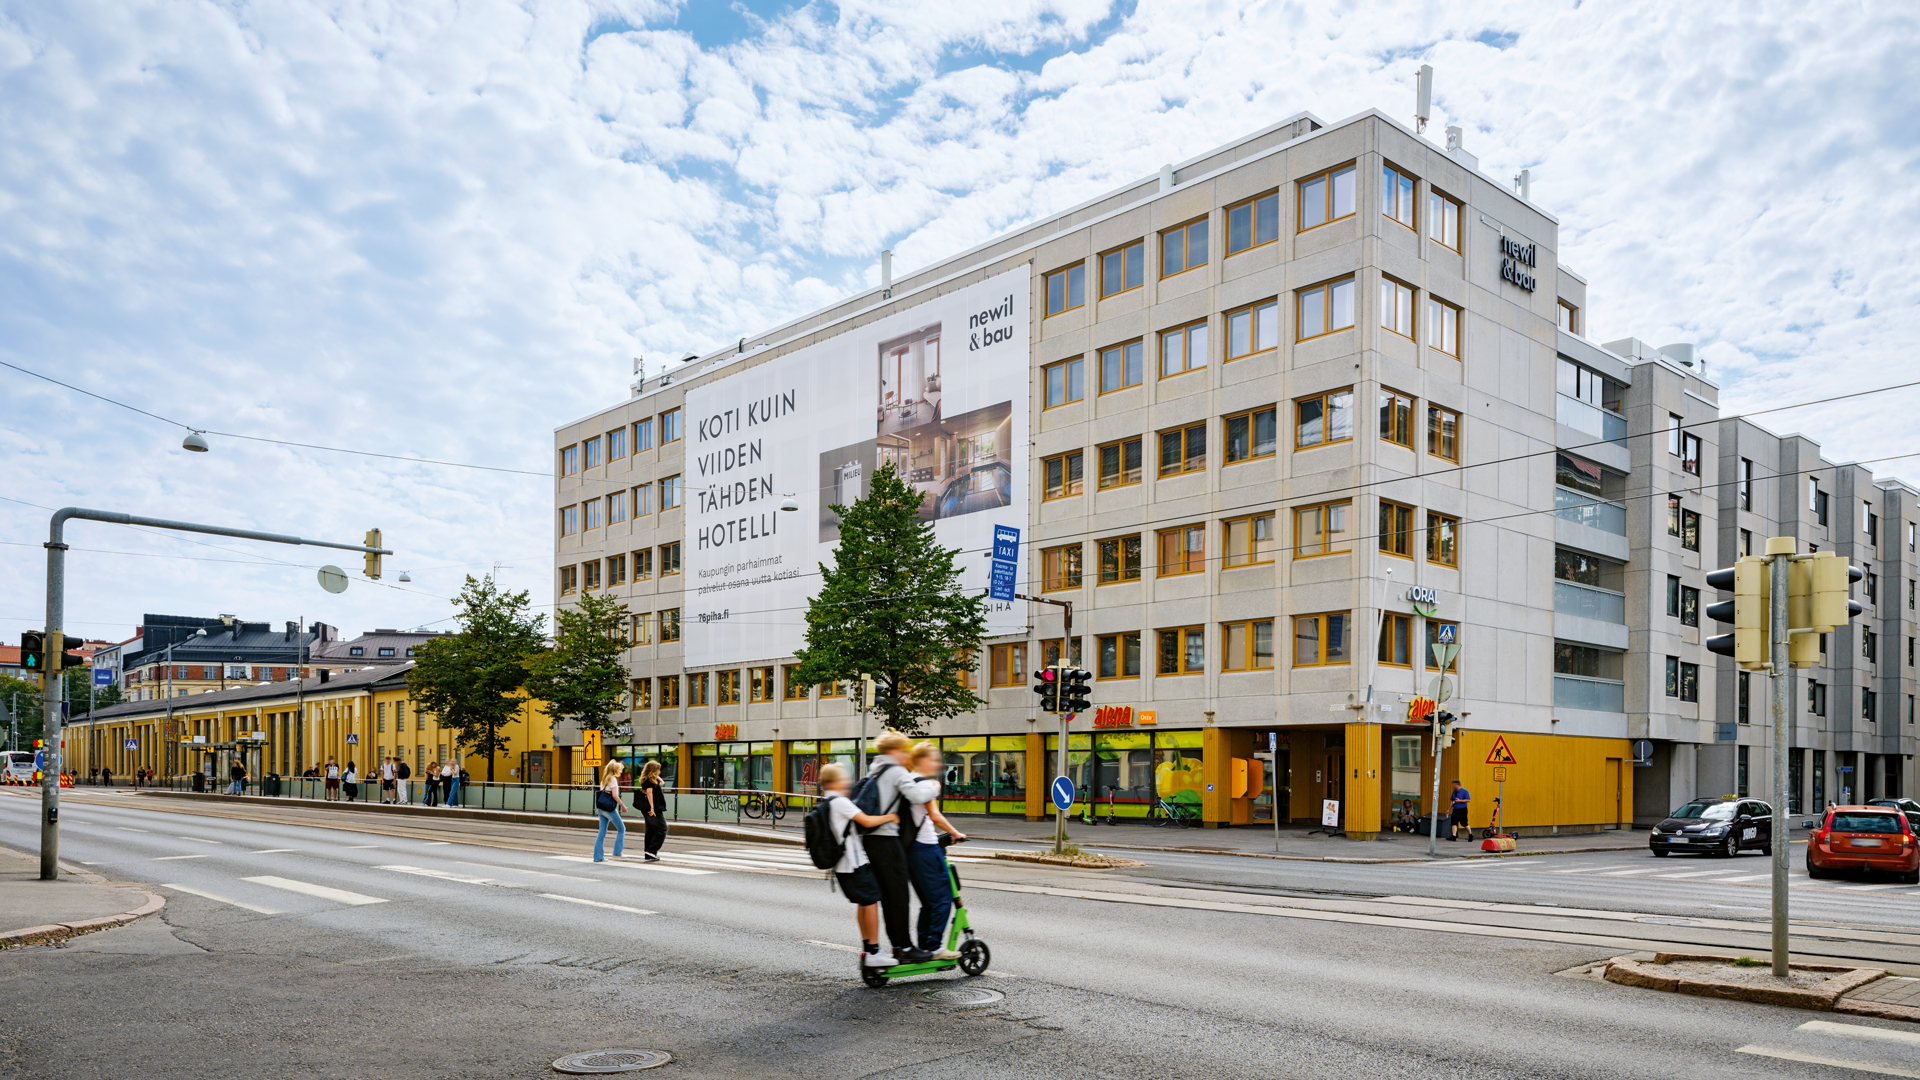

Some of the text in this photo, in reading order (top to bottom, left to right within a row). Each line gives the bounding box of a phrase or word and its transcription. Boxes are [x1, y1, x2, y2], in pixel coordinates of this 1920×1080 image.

[1502, 236, 1536, 268] newil
[1502, 258, 1536, 292] & bau
[970, 294, 1013, 329] newil
[970, 325, 1013, 351] & bau
[700, 389, 794, 442] KOTI KUIN
[698, 438, 761, 477] VIIDEN
[698, 473, 772, 514] TÄHDEN
[699, 511, 776, 550] HOTELLI
[998, 546, 1014, 557] TAXI
[699, 555, 782, 579] Kaupungin parhaimmat
[699, 567, 800, 597] palvelut osana uutta kotiasi
[1413, 586, 1440, 604] ORAL
[698, 609, 729, 624] 76piha.fi
[984, 602, 1011, 613] PIHA
[1094, 705, 1133, 727] alepa
[715, 723, 737, 739] alepa
